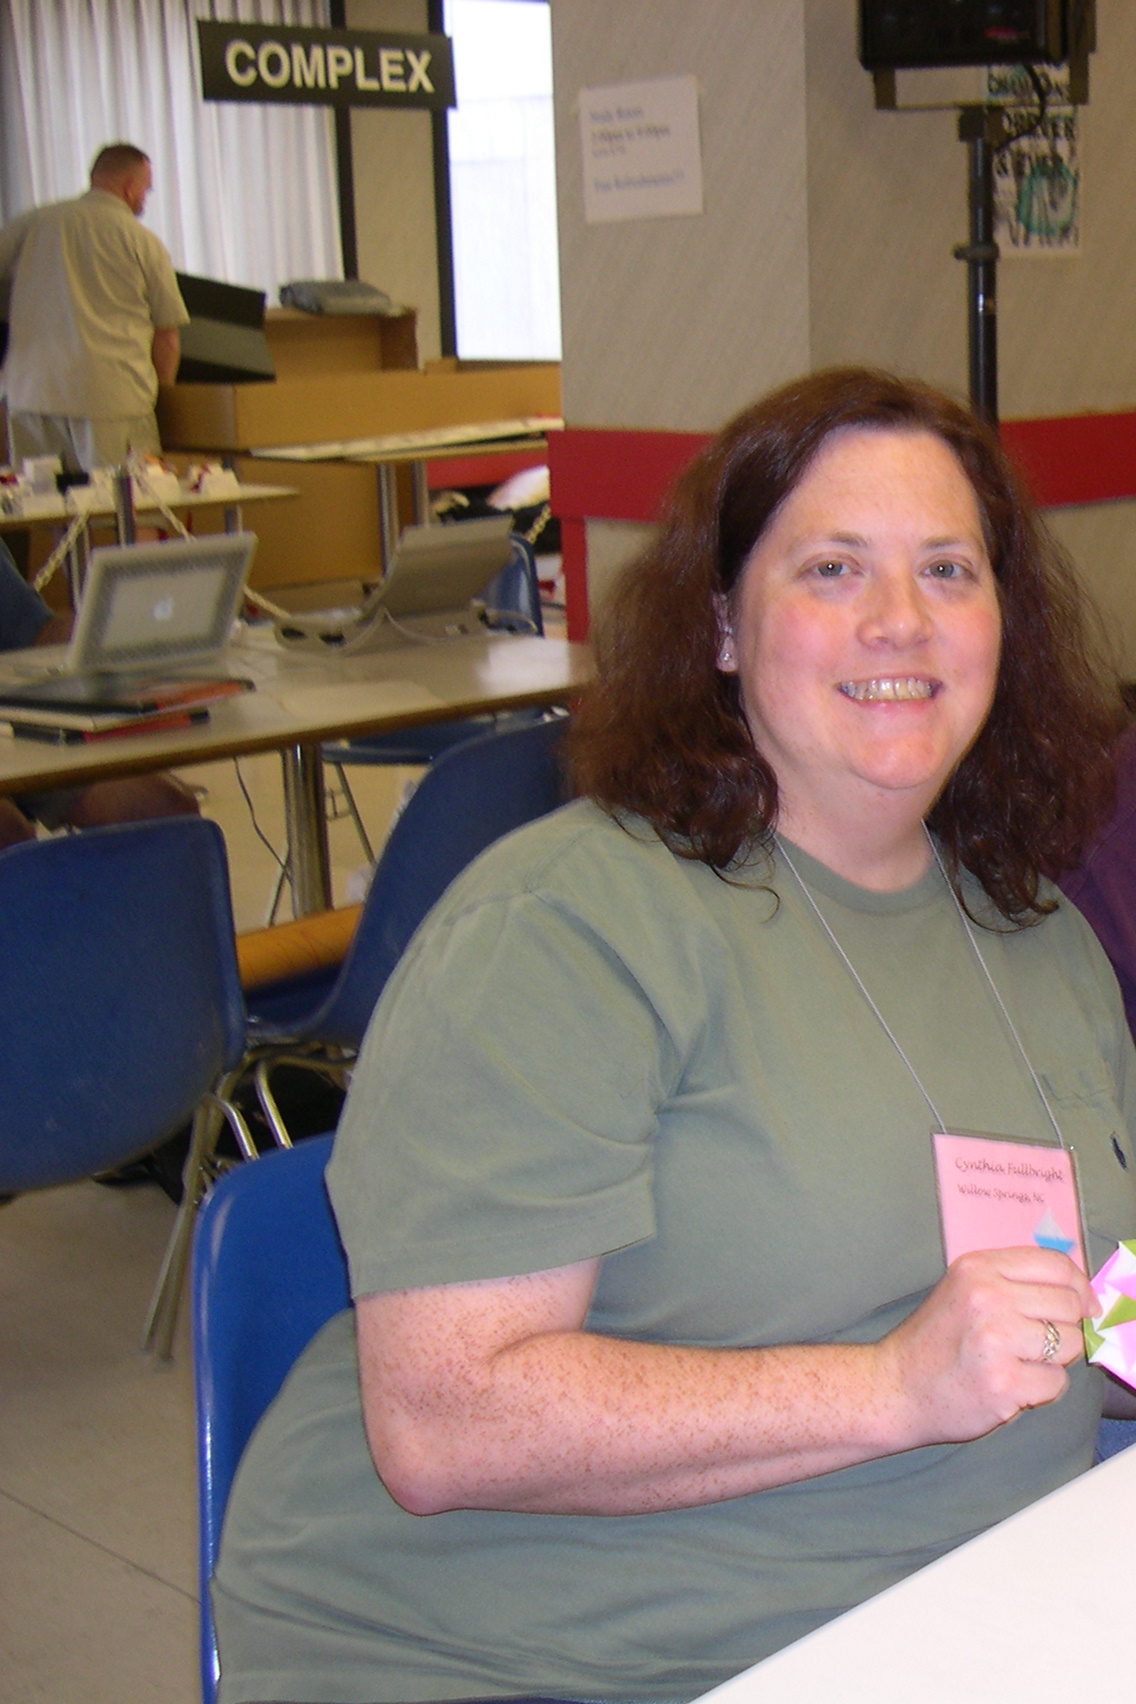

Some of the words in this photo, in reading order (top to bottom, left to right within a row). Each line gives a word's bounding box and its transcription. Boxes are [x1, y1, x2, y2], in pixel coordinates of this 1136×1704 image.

[225, 39, 435, 93] COMPLEX
[955, 1156, 1005, 1173] Cynthia
[957, 1183, 991, 1198] Willow
